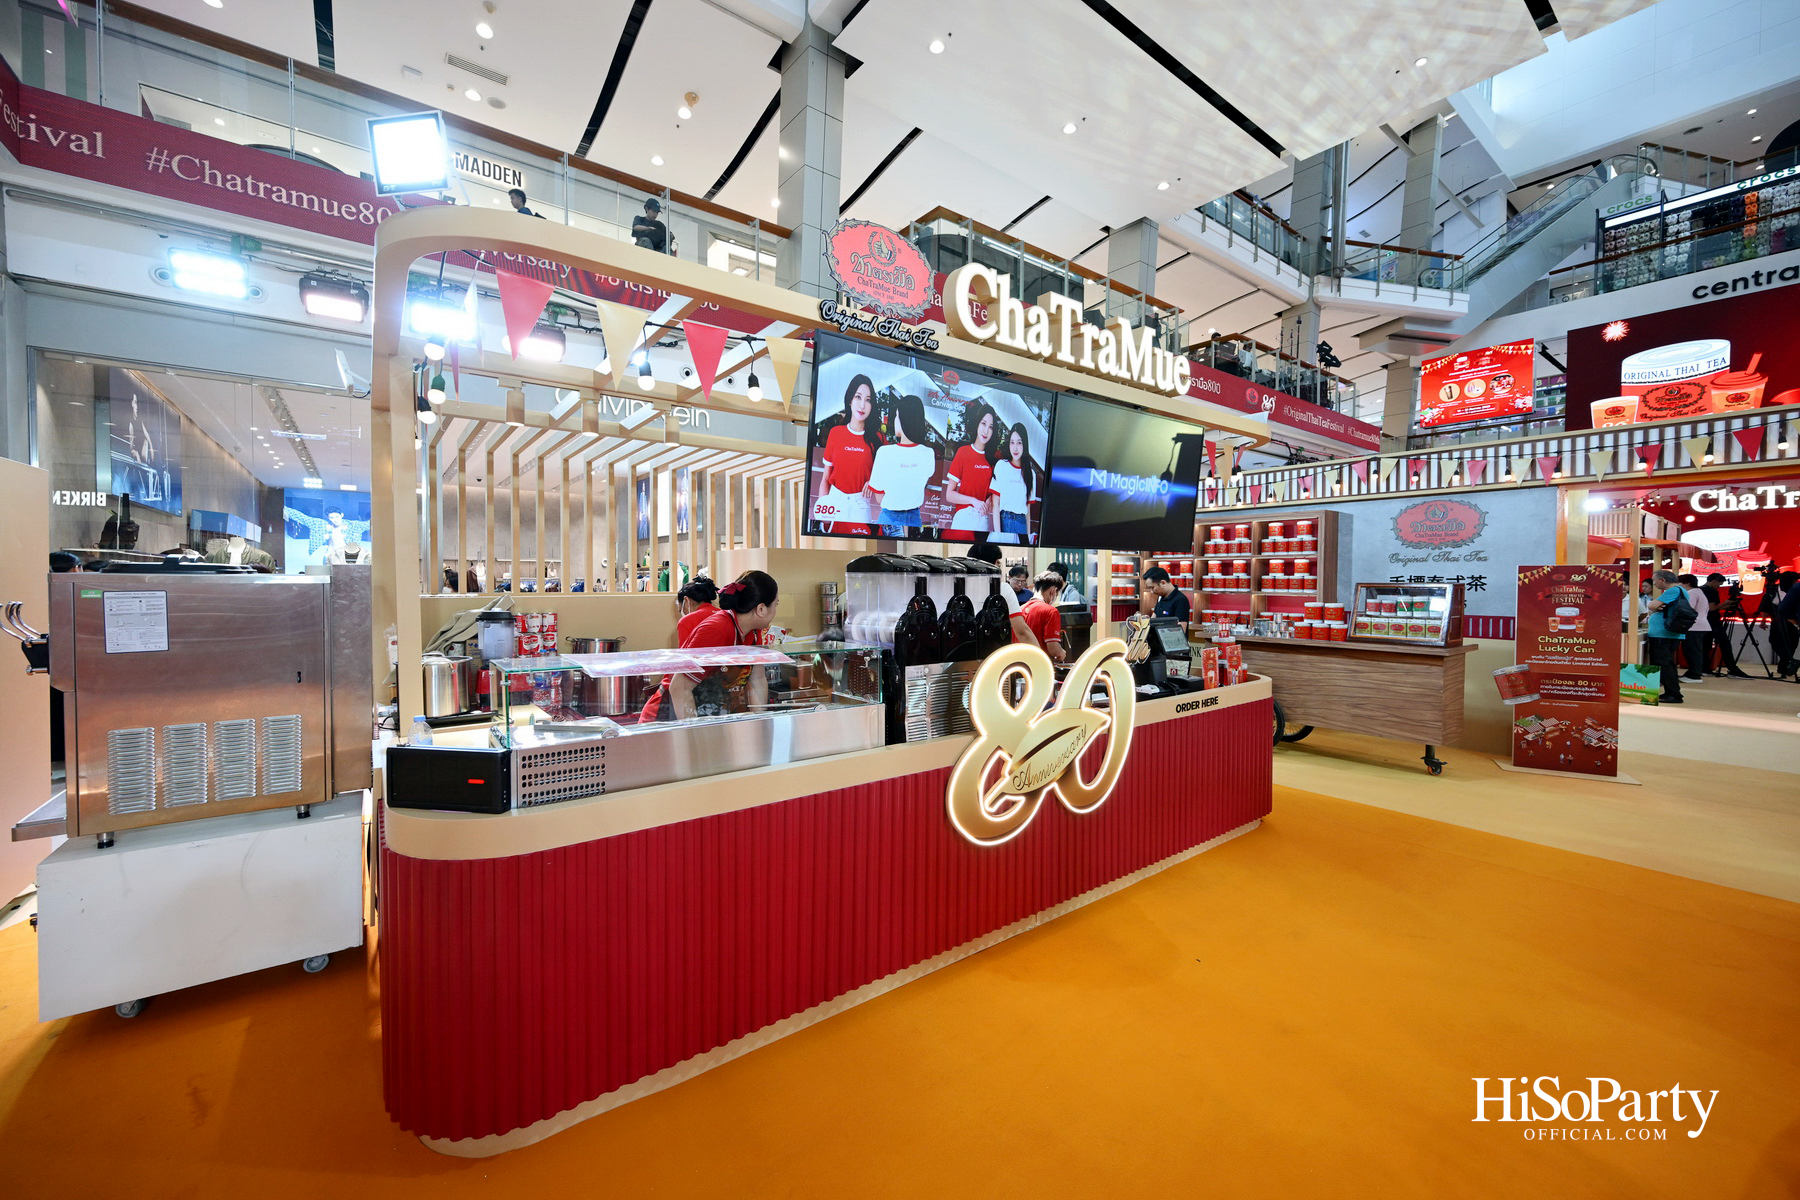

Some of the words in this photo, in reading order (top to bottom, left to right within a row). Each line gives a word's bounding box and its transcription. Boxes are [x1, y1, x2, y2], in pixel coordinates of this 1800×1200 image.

[454, 151, 523, 188] MADDEN
[1737, 166, 1796, 191] crocs
[1606, 194, 1653, 214] crocs
[857, 276, 891, 293] ChaTraMue
[892, 286, 909, 299] Brand
[820, 299, 876, 333] Original
[878, 315, 912, 343] Thai
[911, 327, 940, 351] Tea
[949, 262, 1192, 397] ChaTraMue
[1623, 371, 1672, 381] ORIGINAL
[1674, 363, 1701, 377] THAI
[1706, 356, 1728, 370] TEA
[932, 398, 953, 408] Canvas
[954, 403, 966, 414] Bag
[815, 504, 841, 515] 380.-
[1388, 552, 1430, 567] Original
[1432, 551, 1461, 563] Thai
[1464, 550, 1489, 563] Tea
[1537, 635, 1597, 645] ChaTraMue
[1539, 645, 1570, 654] Lucky
[1573, 645, 1595, 654] Can
[1577, 679, 1589, 687] 80
[1176, 700, 1200, 714] ORDER
[1202, 696, 1219, 709] HERE
[945, 638, 1137, 847] 80
[1012, 724, 1087, 791] Anniversary
